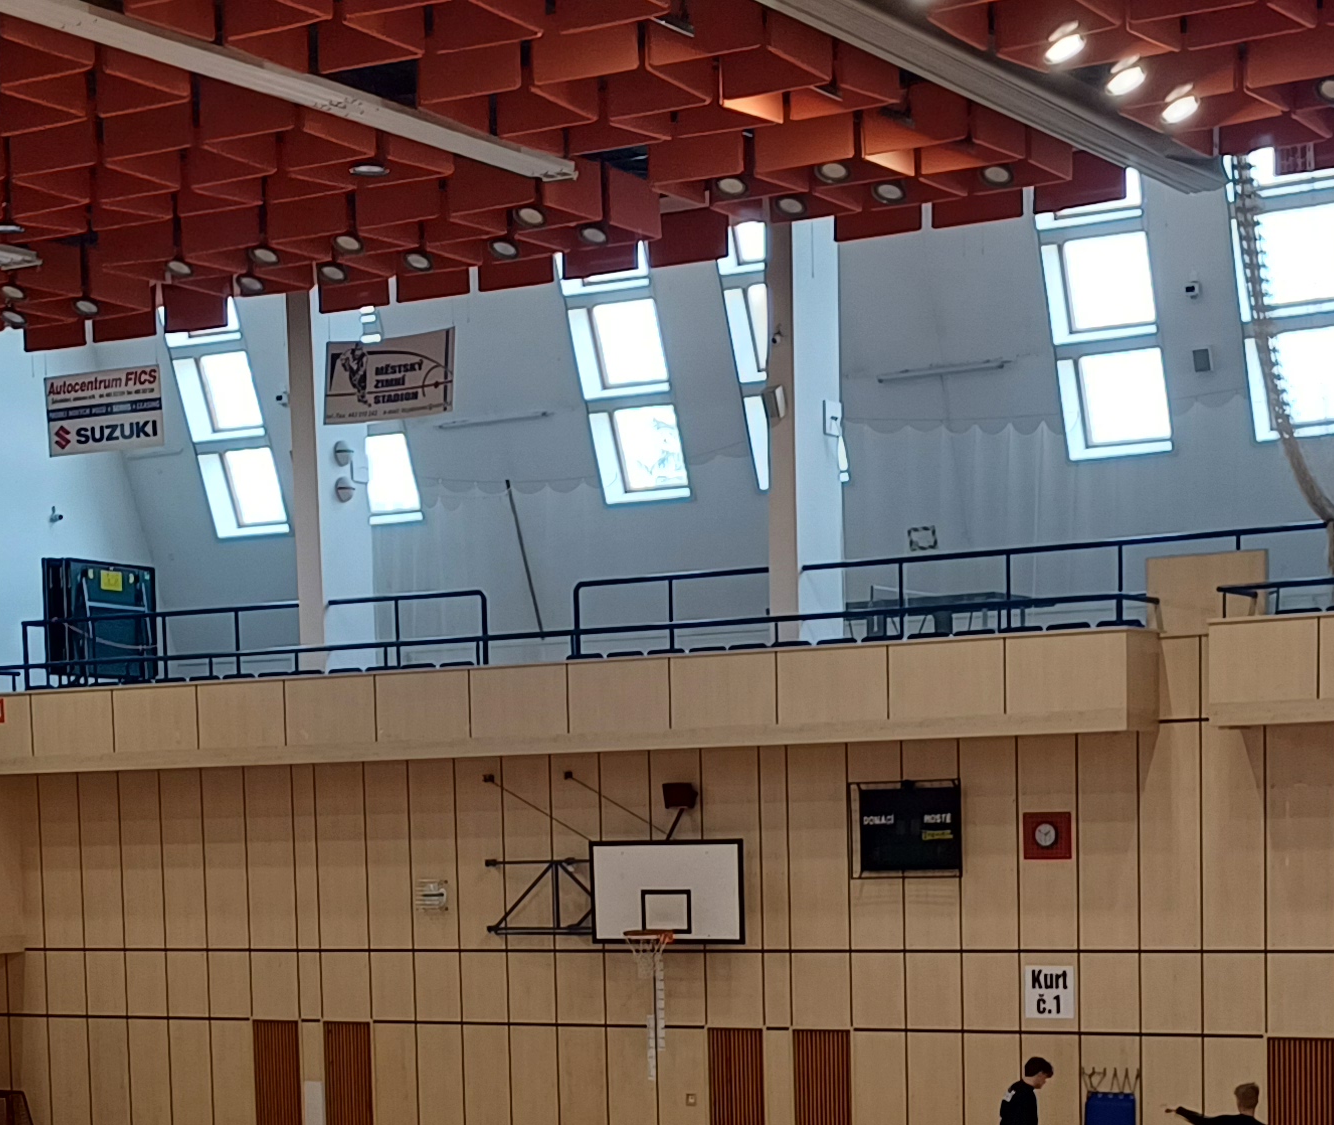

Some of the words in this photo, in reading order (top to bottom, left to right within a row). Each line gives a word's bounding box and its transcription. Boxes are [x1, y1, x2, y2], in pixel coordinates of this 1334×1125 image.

[48, 377, 122, 396] Autocentrum
[125, 369, 157, 387] FICS
[374, 391, 419, 405] STADION
[76, 420, 158, 444] SUZUKI
[1032, 969, 1068, 989] Kurt
[1037, 993, 1061, 1014] č.1
